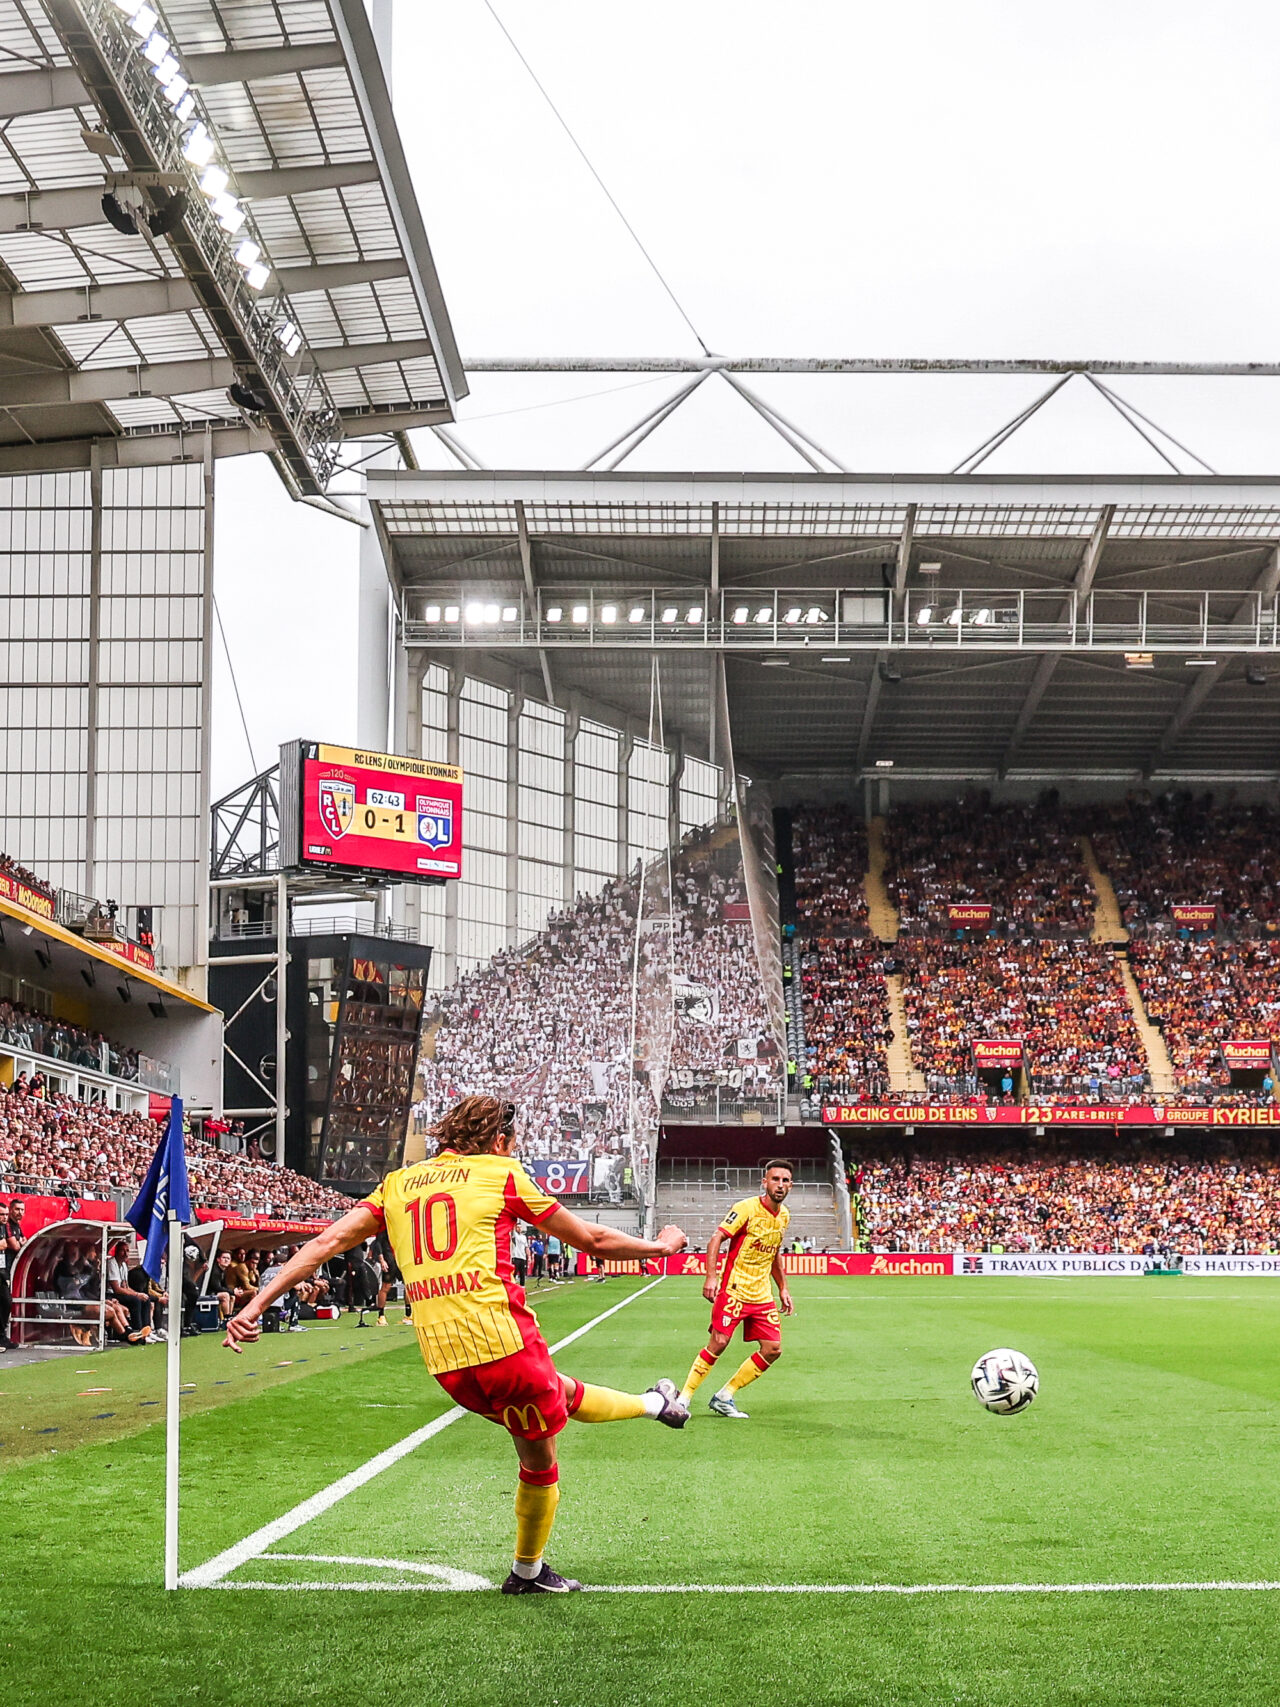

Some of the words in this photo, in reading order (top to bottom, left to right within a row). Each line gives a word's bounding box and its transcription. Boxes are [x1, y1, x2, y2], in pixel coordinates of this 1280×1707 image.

[354, 754, 364, 765] RC
[365, 755, 383, 768] LENS
[388, 759, 426, 775] OLYMPIQUE
[426, 765, 459, 779] LYONNAIS
[371, 792, 400, 807] 62:43
[419, 799, 449, 809] OLYMPIQUE
[420, 806, 449, 816] LYONNAIS
[364, 809, 376, 829] 0
[395, 814, 405, 833] 1
[420, 816, 448, 841] OL
[949, 906, 990, 918] Auchan
[1173, 907, 1214, 920] Auchan
[974, 1043, 1020, 1056] Auchan
[1224, 1043, 1270, 1057] Auchan
[841, 1108, 890, 1121] RACING
[893, 1108, 926, 1121] CLUB
[928, 1108, 946, 1121] DE
[949, 1108, 978, 1121] LENS
[1020, 1107, 1053, 1123] 123
[1055, 1110, 1125, 1120] PARE-BRISE
[1166, 1111, 1209, 1121] GROUPE
[403, 1168, 471, 1192] THAUVIN
[546, 1163, 587, 1192] 87
[405, 1192, 458, 1265] 10
[750, 1239, 777, 1254] Auch
[782, 1256, 828, 1274] UMA
[870, 1255, 945, 1274] Auchan
[990, 1260, 1058, 1271] TRAVAUX
[1063, 1260, 1126, 1271] PUBLICS
[723, 1296, 743, 1318] 28
